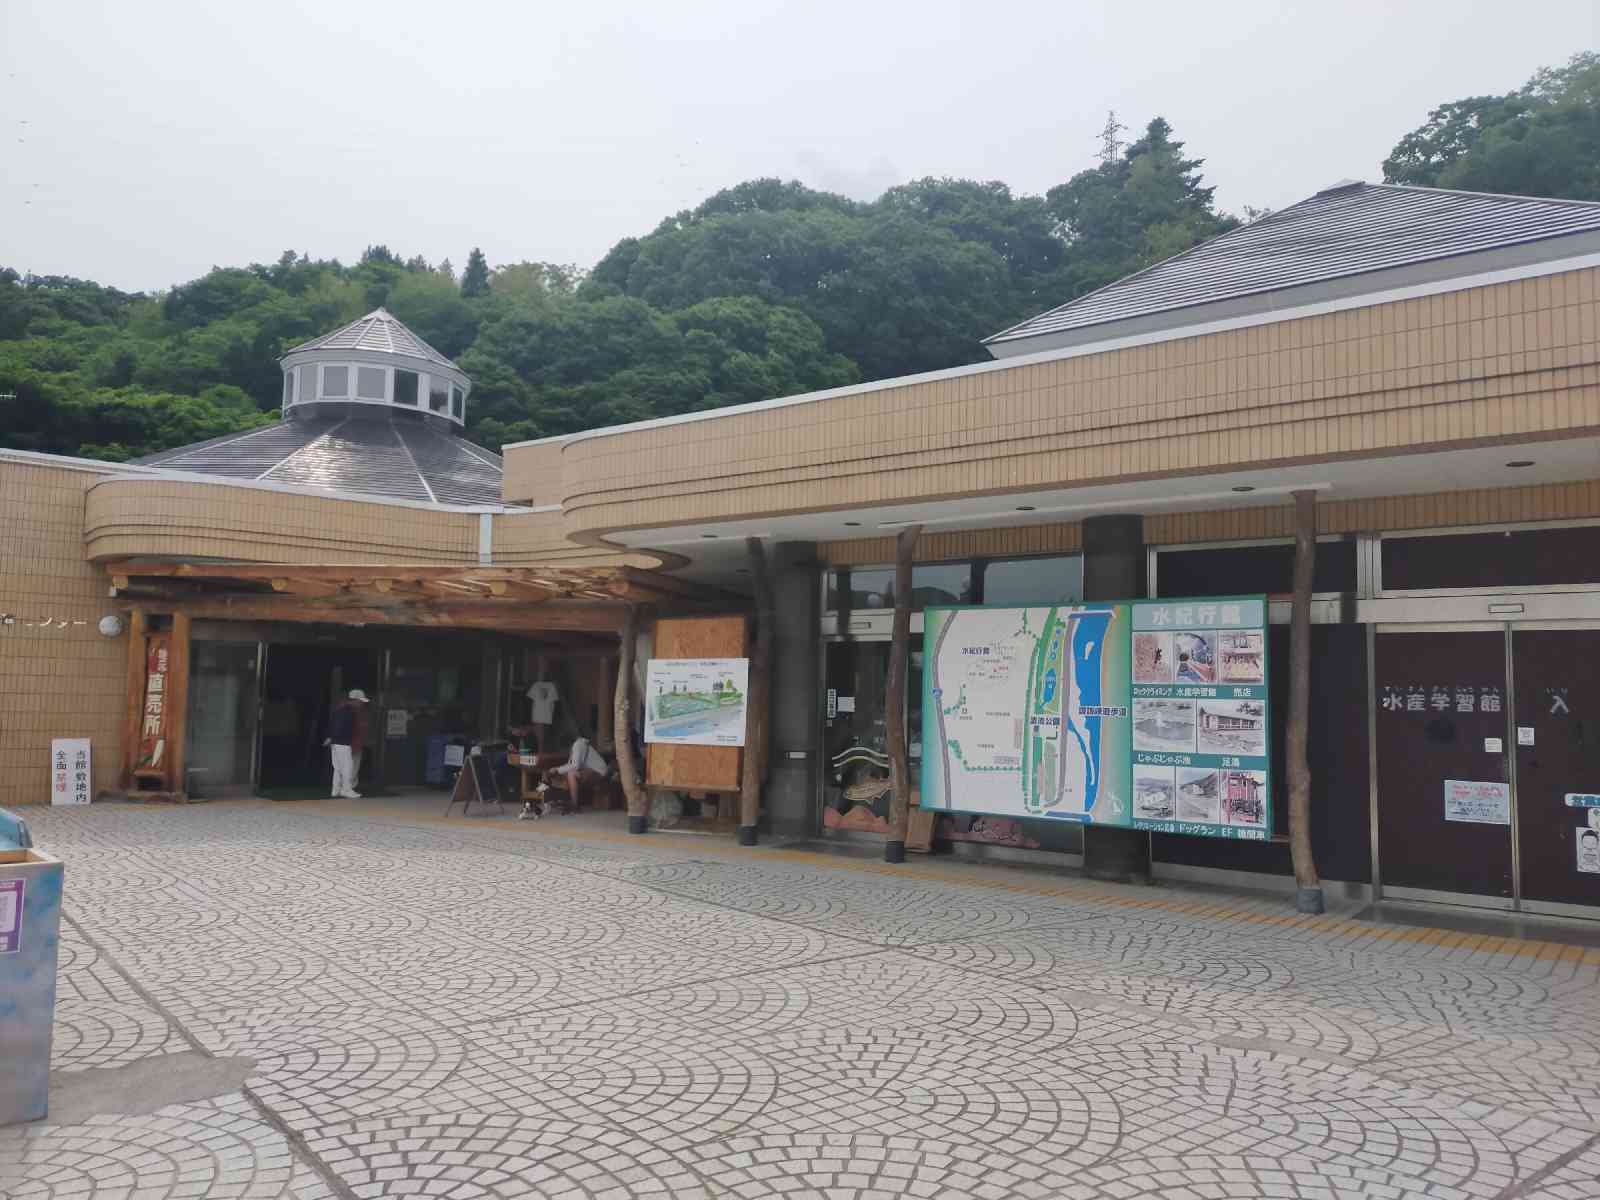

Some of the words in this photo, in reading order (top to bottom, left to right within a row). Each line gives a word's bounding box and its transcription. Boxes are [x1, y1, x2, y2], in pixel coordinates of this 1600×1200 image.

[1175, 687, 1217, 698] 水産学習館
[1233, 687, 1252, 698] 売店
[145, 672, 164, 736] 直売所
[1382, 693, 1501, 713] 水産学習館
[1550, 695, 1570, 714] 入
[1179, 823, 1216, 836] ドッグラン
